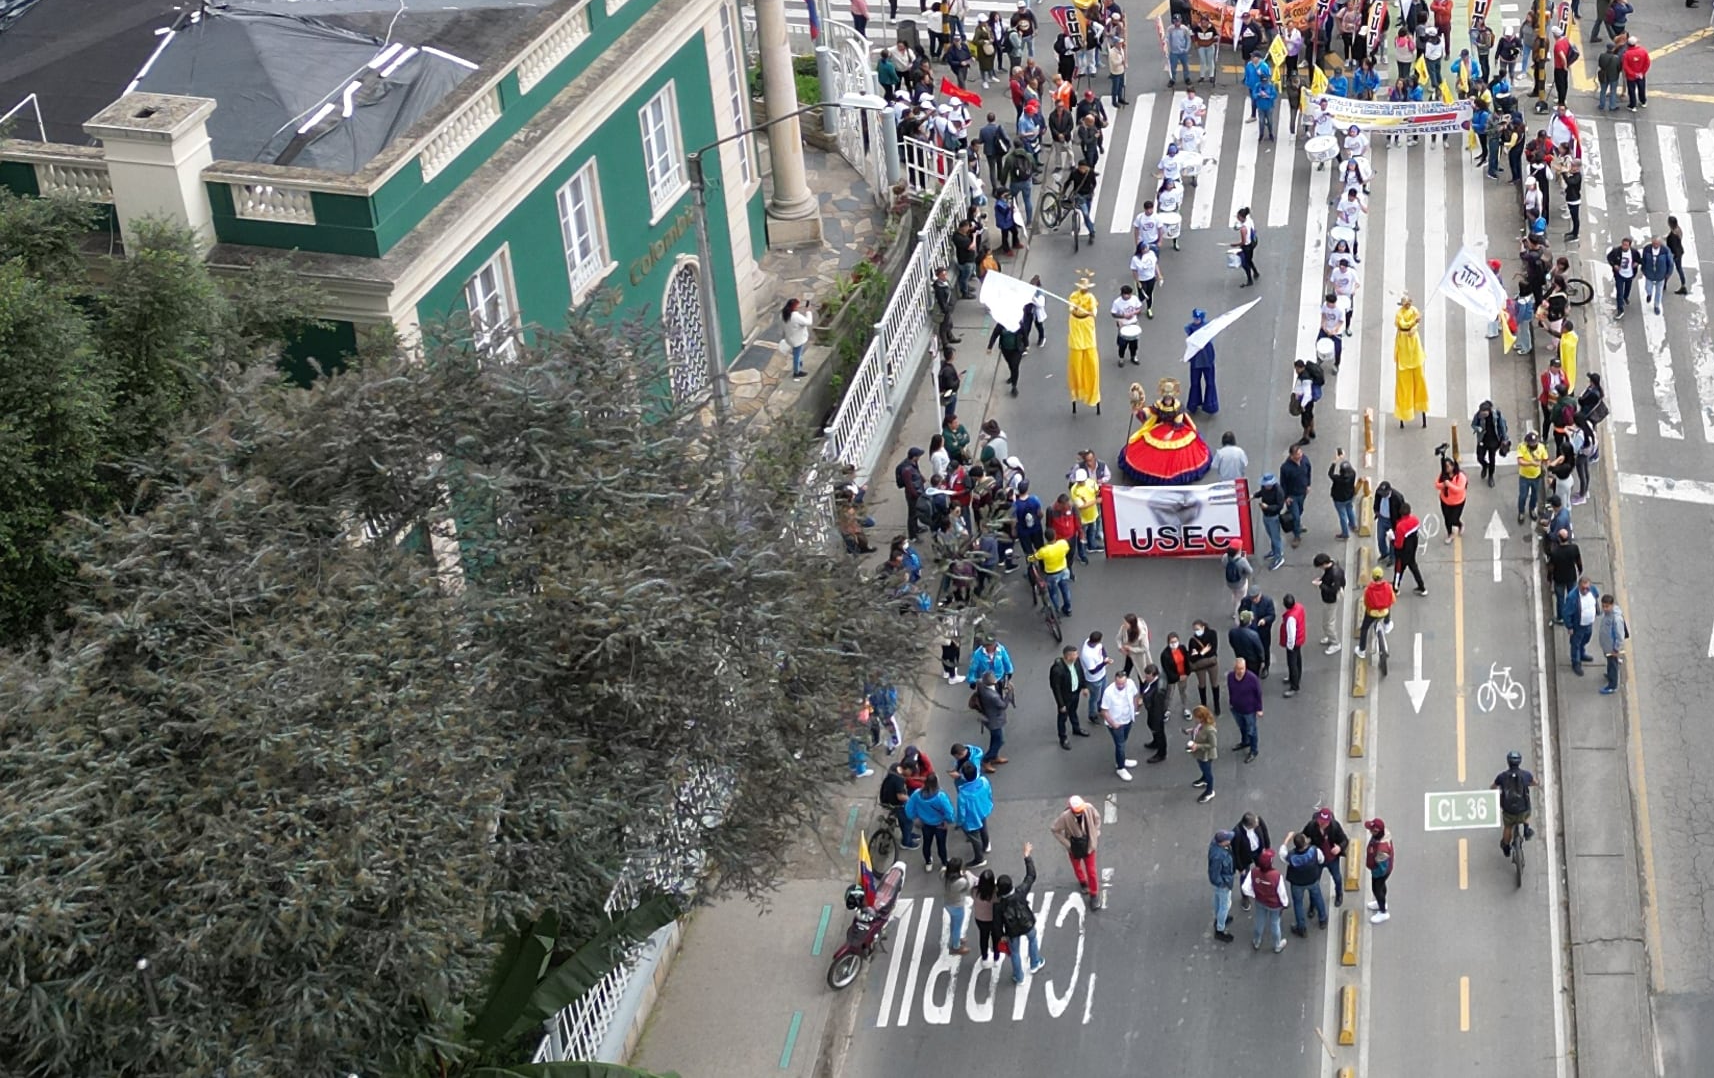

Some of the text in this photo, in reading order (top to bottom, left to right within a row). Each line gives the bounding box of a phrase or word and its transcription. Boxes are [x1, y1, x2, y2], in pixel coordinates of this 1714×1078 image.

[1369, 2, 1382, 45] CUT
[1130, 525, 1231, 552] USEC
[1438, 797, 1488, 822] CL 36
